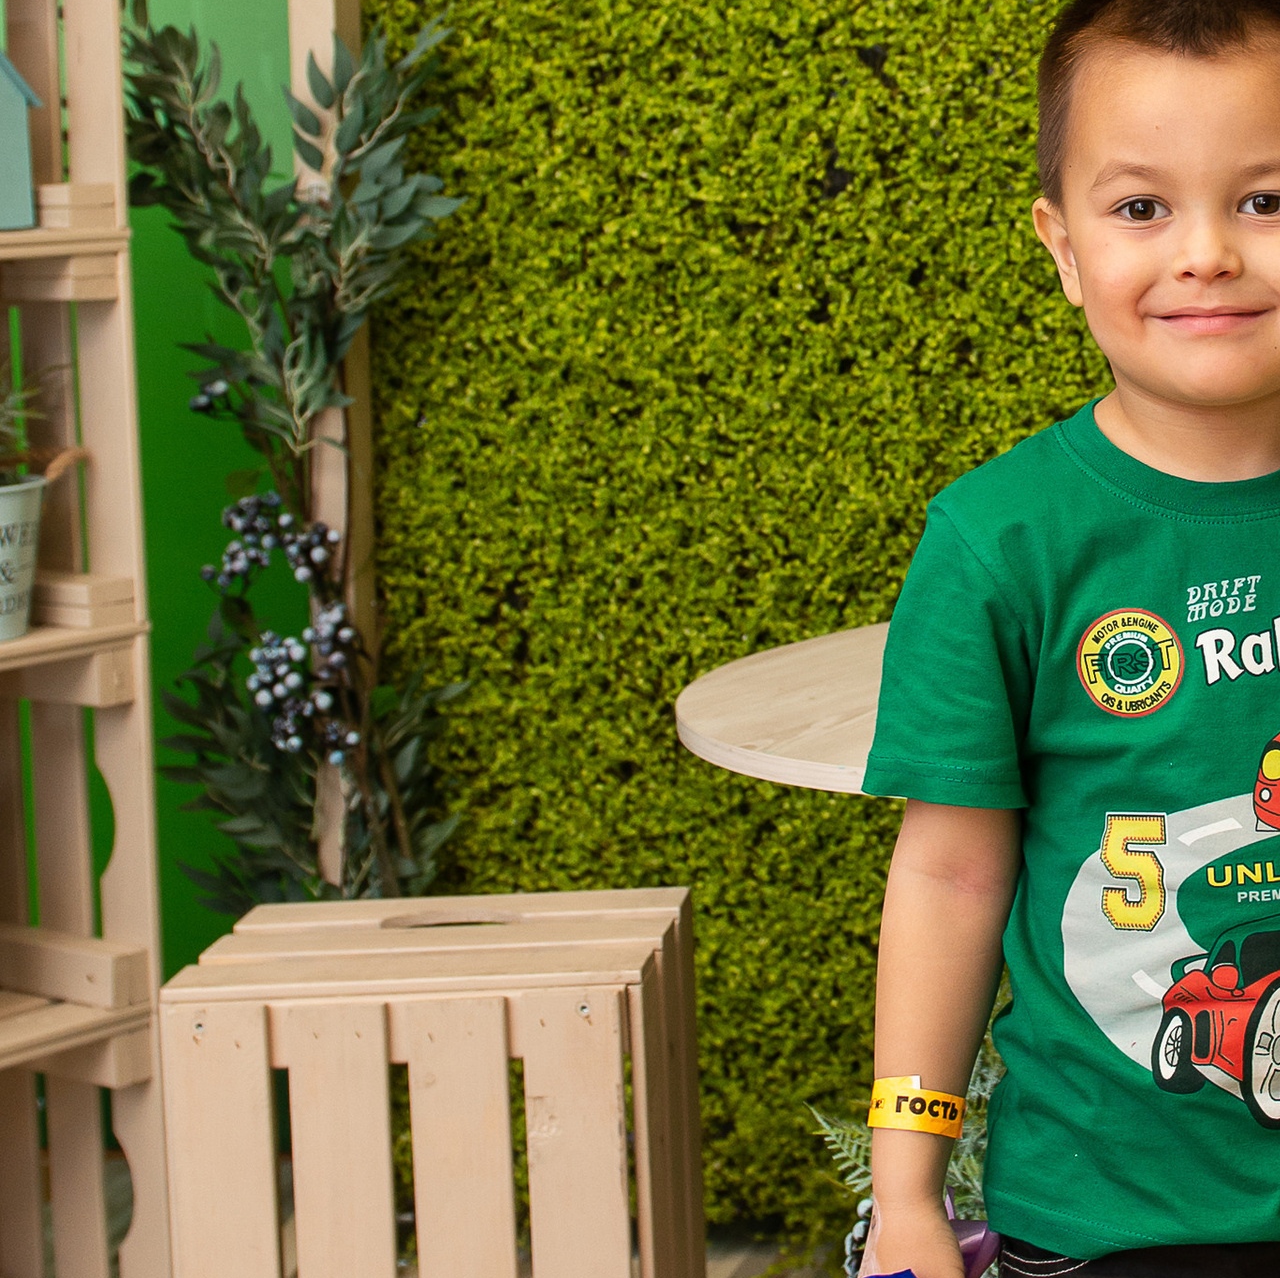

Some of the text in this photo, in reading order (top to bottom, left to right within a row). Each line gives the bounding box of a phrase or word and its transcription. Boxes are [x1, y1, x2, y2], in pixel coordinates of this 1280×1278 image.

[1186, 575, 1262, 606] DRIFT
[1187, 594, 1257, 623] MODE
[1092, 620, 1120, 644] MOTOR
[1104, 632, 1149, 649] PREMIUM
[1084, 638, 1174, 684] FIRST
[1101, 813, 1167, 931] 5
[895, 1095, 958, 1121] ГОСТЬ
